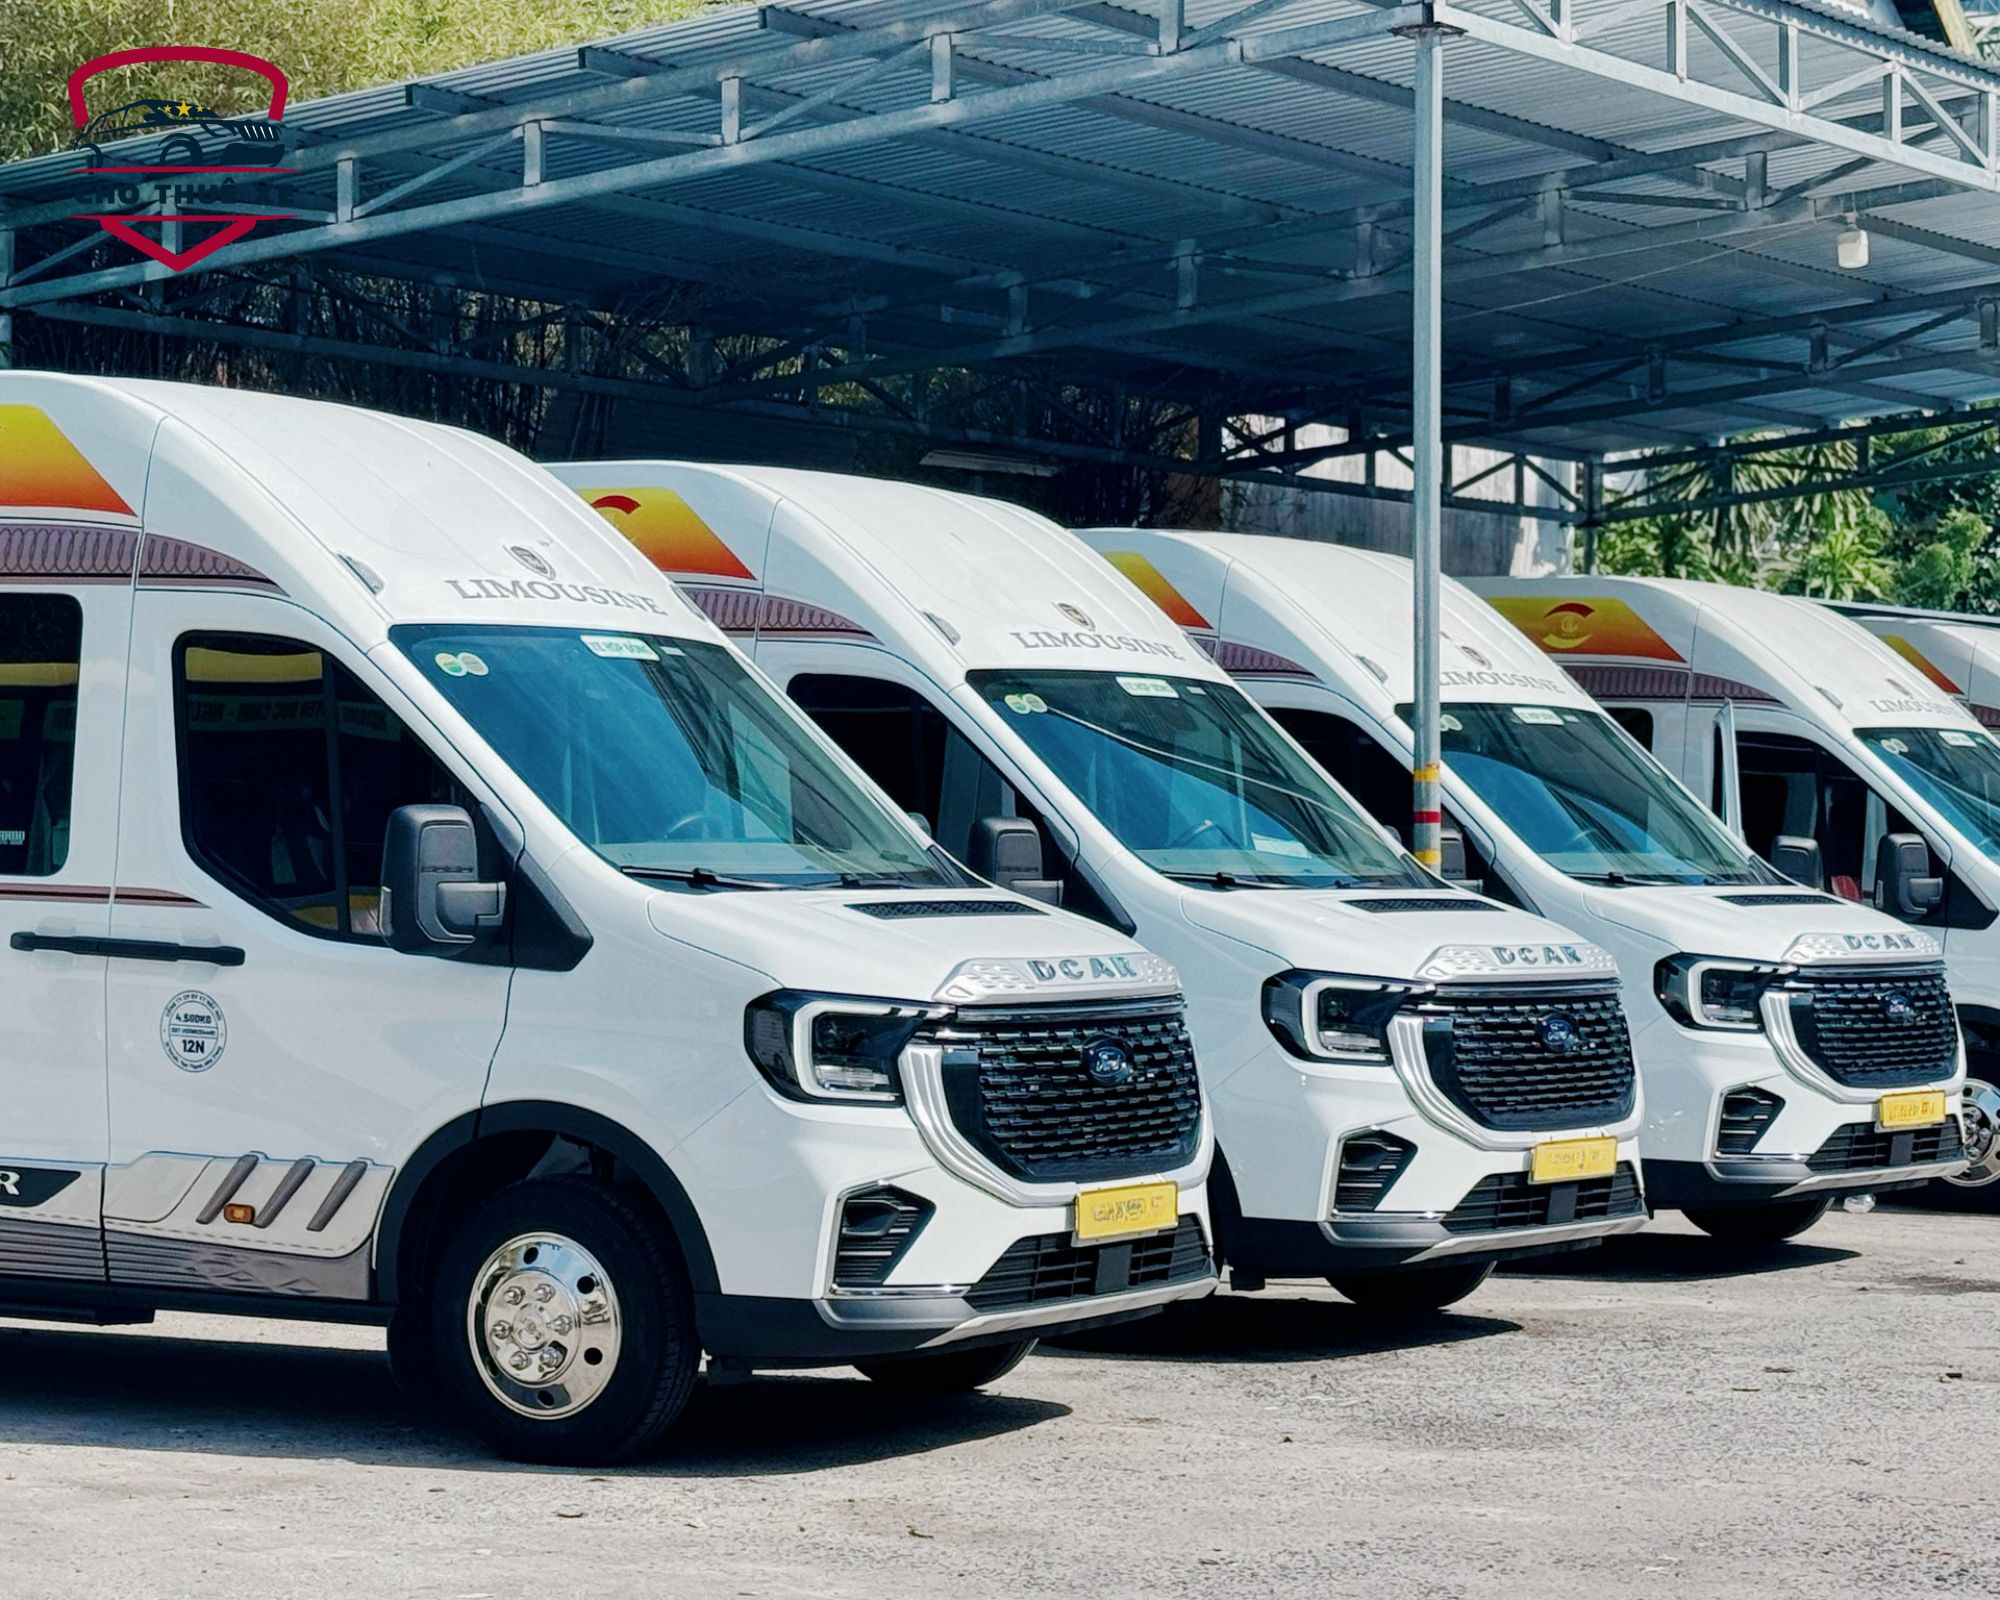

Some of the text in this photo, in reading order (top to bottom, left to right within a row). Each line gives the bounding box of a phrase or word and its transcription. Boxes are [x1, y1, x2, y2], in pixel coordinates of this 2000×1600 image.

[444, 579, 668, 616] LIMOUSINE
[1011, 632, 1185, 661] LIMOUSINE
[1843, 934, 1916, 950] DCAR
[1491, 946, 1582, 965] DCAR
[1026, 956, 1138, 981] DCAR
[182, 1039, 206, 1055] 12N
